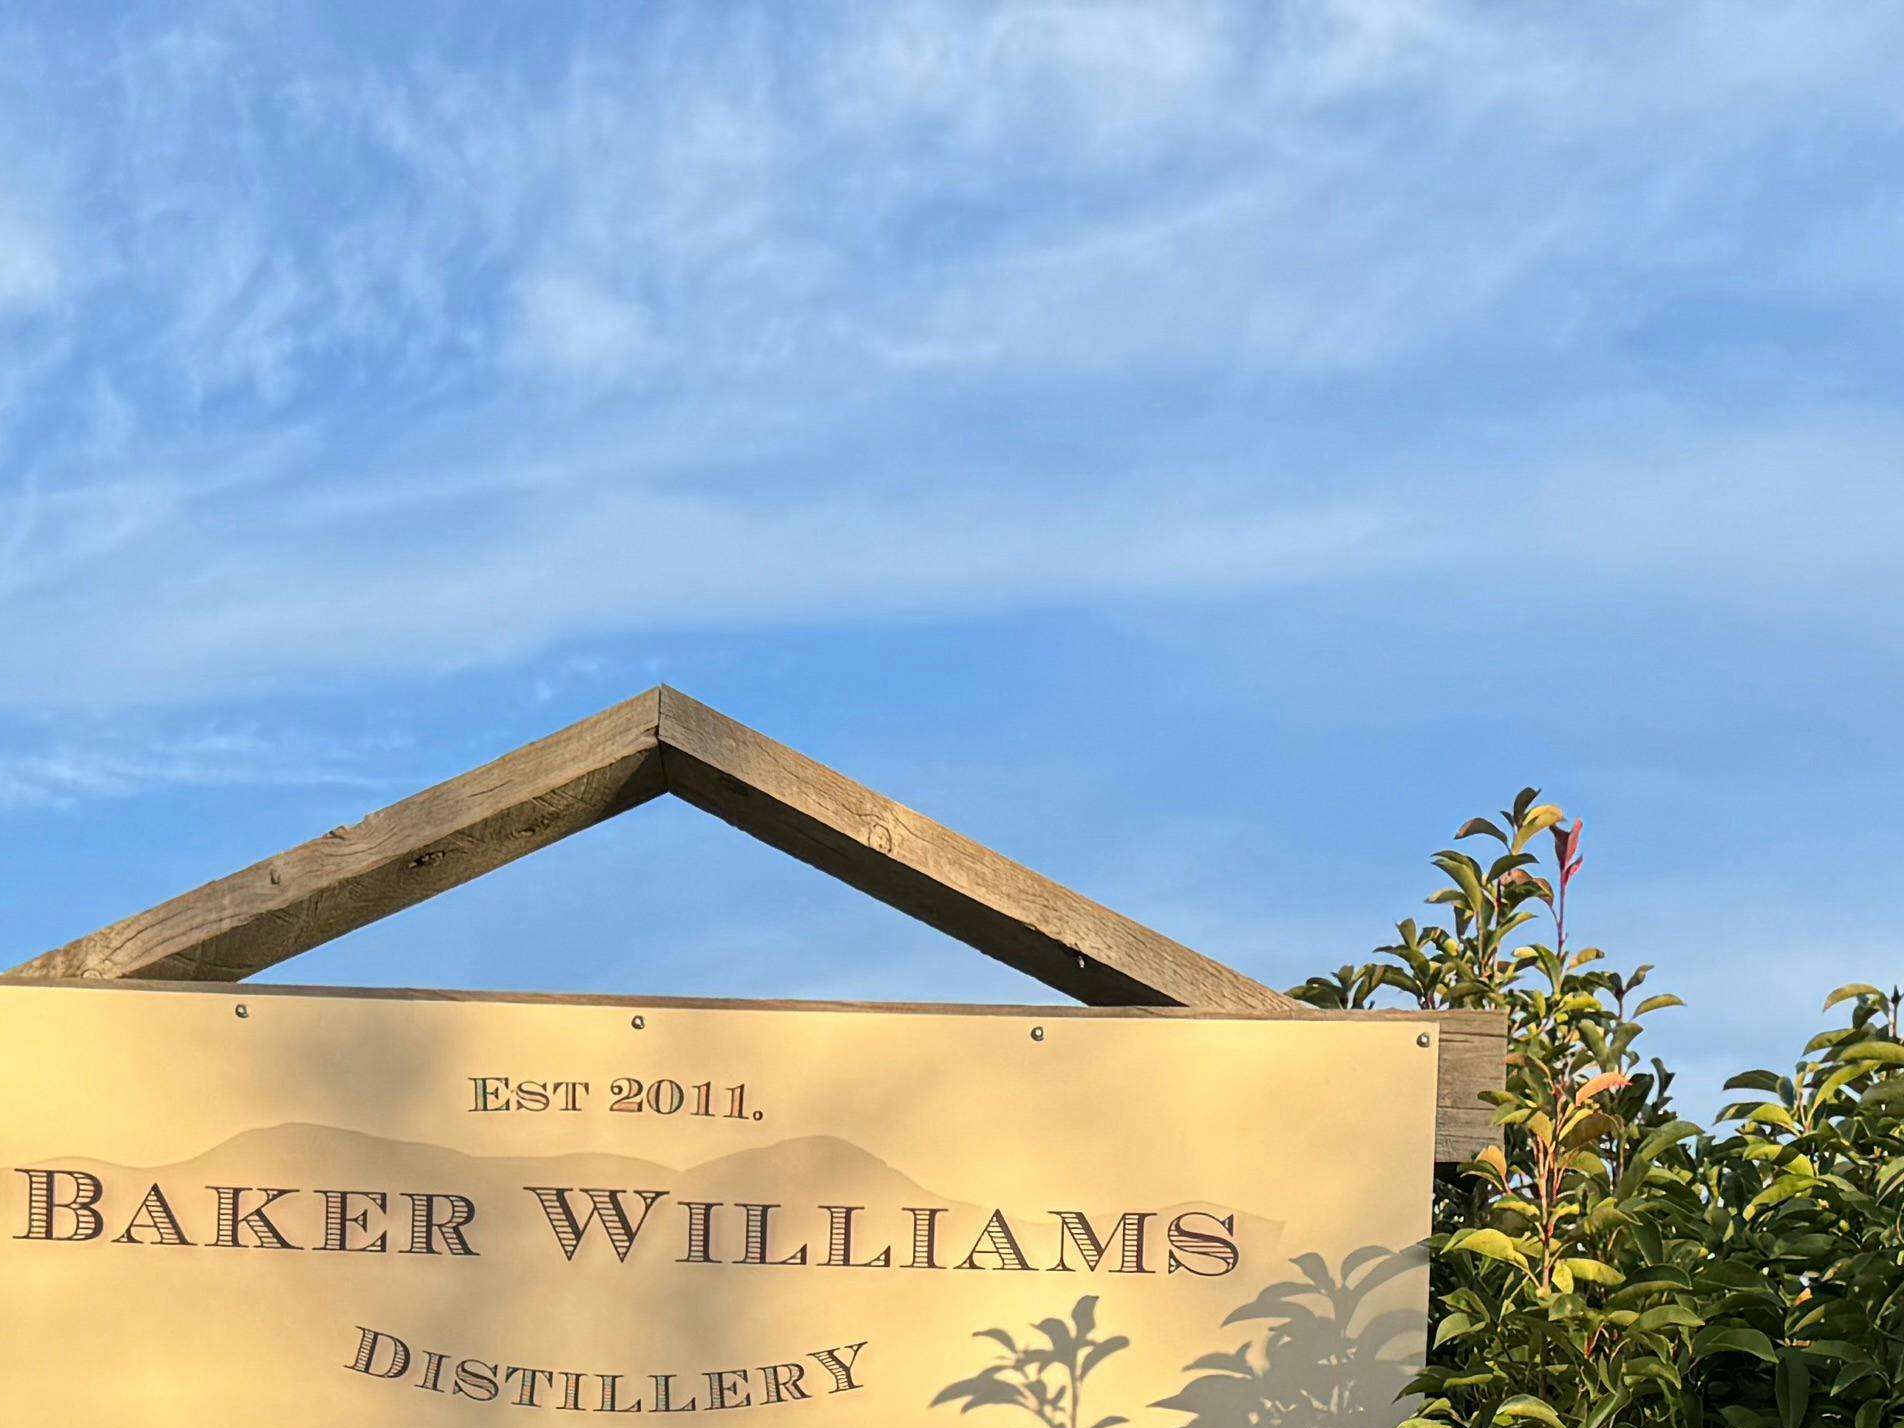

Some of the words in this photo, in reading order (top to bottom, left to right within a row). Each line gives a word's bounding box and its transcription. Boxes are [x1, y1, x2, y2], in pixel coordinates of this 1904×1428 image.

[608, 1076, 765, 1122] 2011.
[12, 1167, 481, 1257] BAKER
[522, 1187, 1241, 1277] WILLIAMS
[343, 1325, 871, 1414] DISTILLERY
